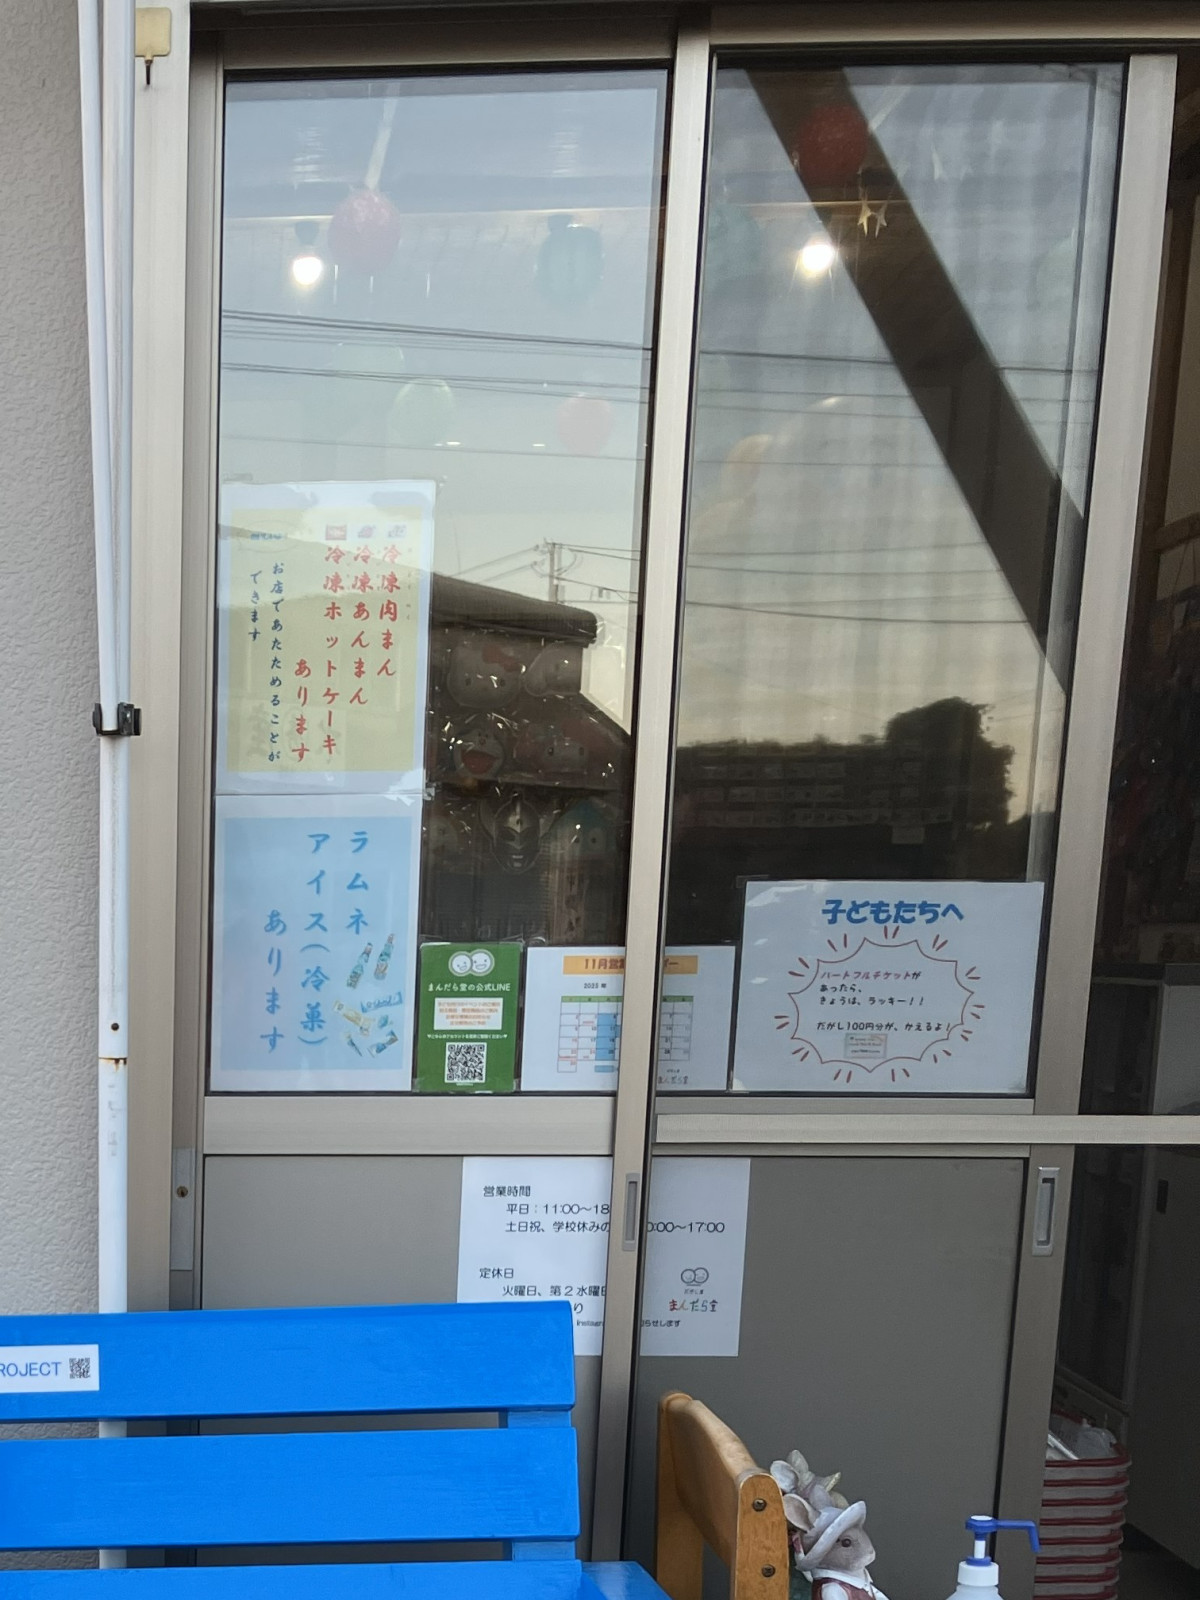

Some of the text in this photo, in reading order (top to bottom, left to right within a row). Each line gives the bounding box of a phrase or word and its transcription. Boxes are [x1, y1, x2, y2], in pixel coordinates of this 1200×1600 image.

[247, 569, 263, 643] できます
[349, 543, 375, 706] 冷凍あんまん
[376, 543, 403, 678] 冷凍肉まん
[267, 561, 285, 763] お店であたためることが
[322, 543, 347, 756] 冷凍ホットケーキ
[290, 658, 312, 763] あります
[345, 830, 370, 936] ラムネ
[821, 899, 965, 925] 子どもたちへ
[260, 908, 288, 1054] あります
[427, 982, 511, 993] まんだら堂の公式LINE
[820, 970, 922, 981] ハートフルチケットが
[820, 983, 863, 994] あったら、
[483, 1185, 531, 1197] 営業時間
[506, 1203, 610, 1215] 平日：11:00～18
[479, 1267, 514, 1279] 定休日
[669, 1299, 718, 1313] まんだら堂
